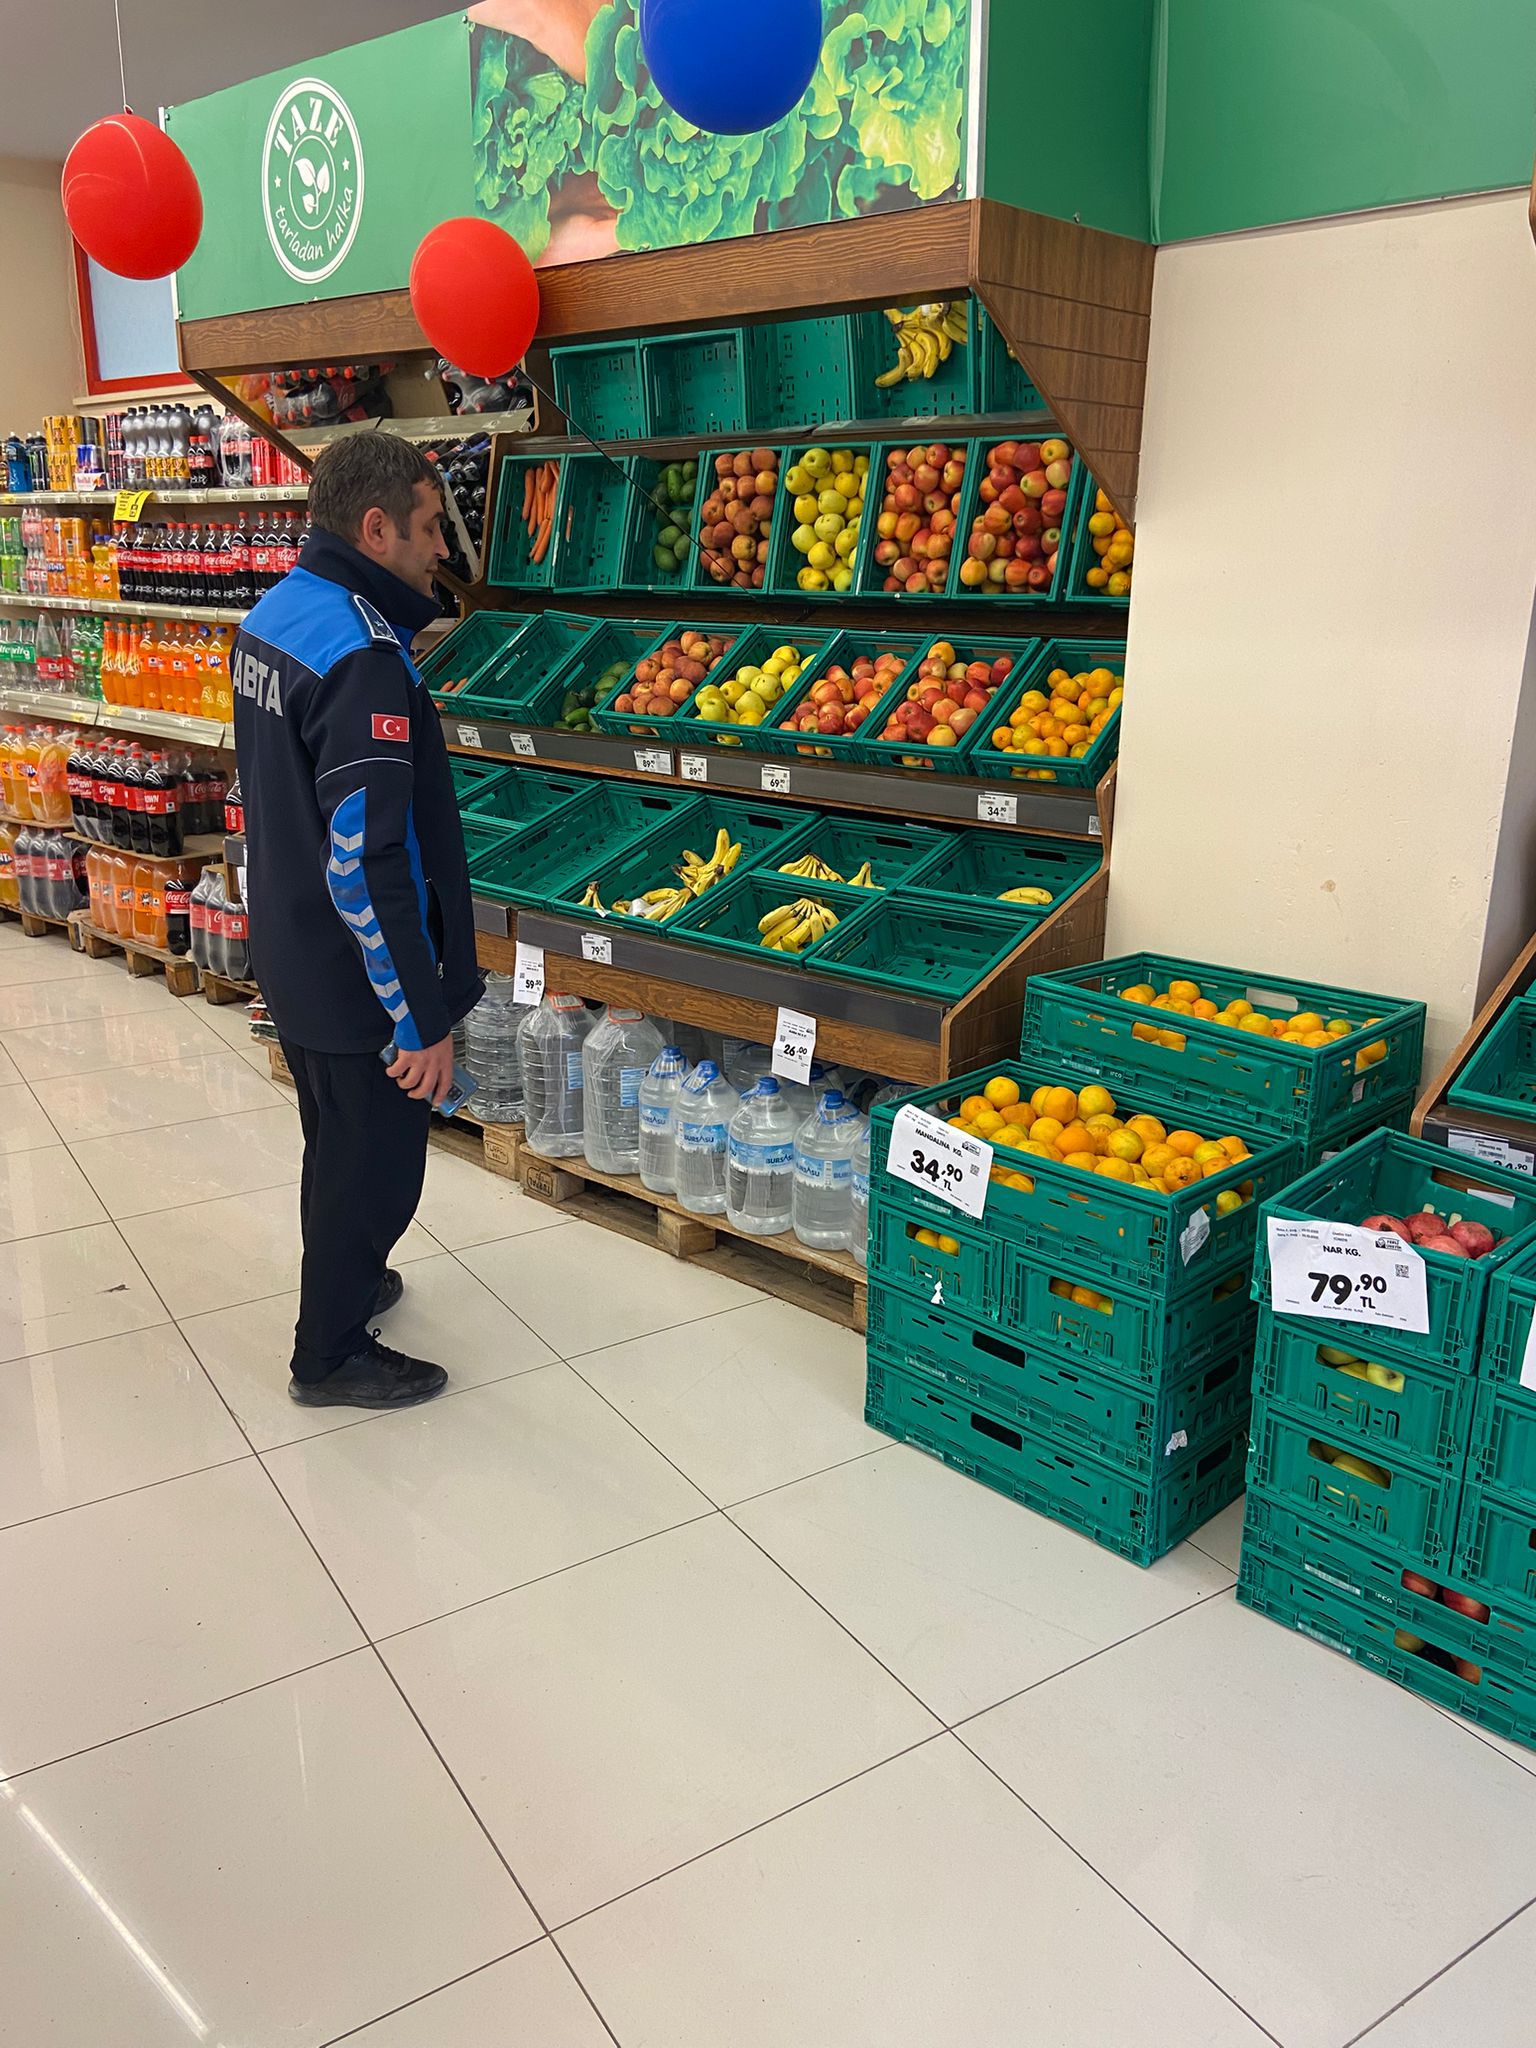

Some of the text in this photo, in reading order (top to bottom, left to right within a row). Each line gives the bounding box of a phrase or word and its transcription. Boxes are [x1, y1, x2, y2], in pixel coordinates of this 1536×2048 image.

[275, 97, 343, 157] TAZE
[275, 186, 353, 261] tarladan halka
[232, 648, 283, 717] ABTA
[943, 1179, 952, 1192] TL
[1323, 1245, 1361, 1257] NAR KG.
[1360, 1296, 1376, 1309] TL
